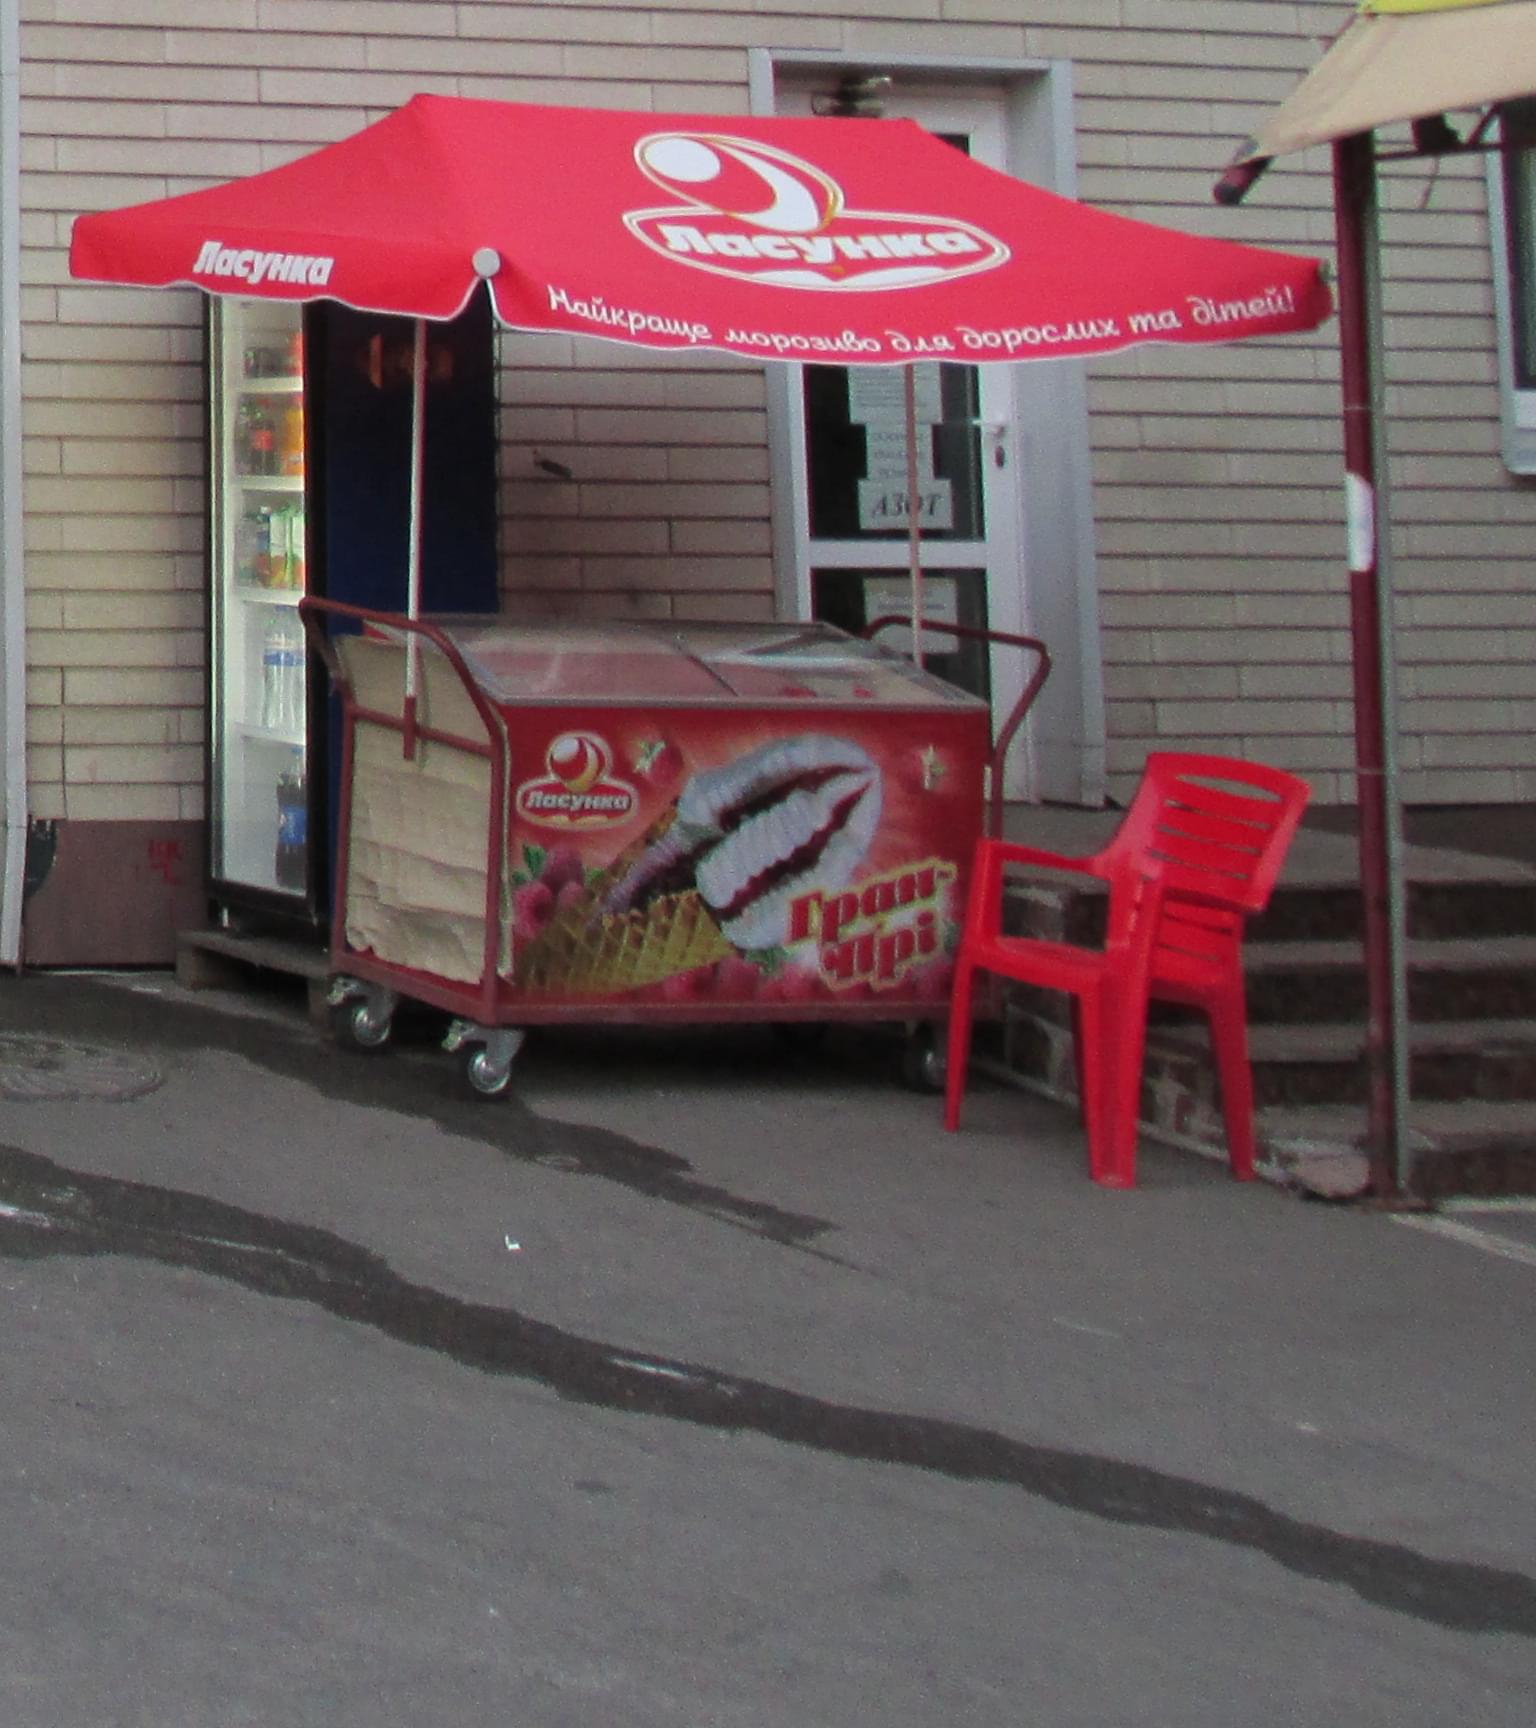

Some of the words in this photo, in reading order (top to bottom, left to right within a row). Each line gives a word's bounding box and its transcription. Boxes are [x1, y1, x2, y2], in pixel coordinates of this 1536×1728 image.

[192, 240, 335, 286] Ласунка
[655, 223, 984, 264] Ласунка
[546, 283, 713, 344] Найкраще
[724, 327, 882, 353] морозиво
[884, 329, 955, 354] для
[955, 319, 1120, 354] дорослих
[1127, 308, 1180, 333] та
[1185, 284, 1296, 327] дітей!
[525, 790, 629, 812] Ласунка
